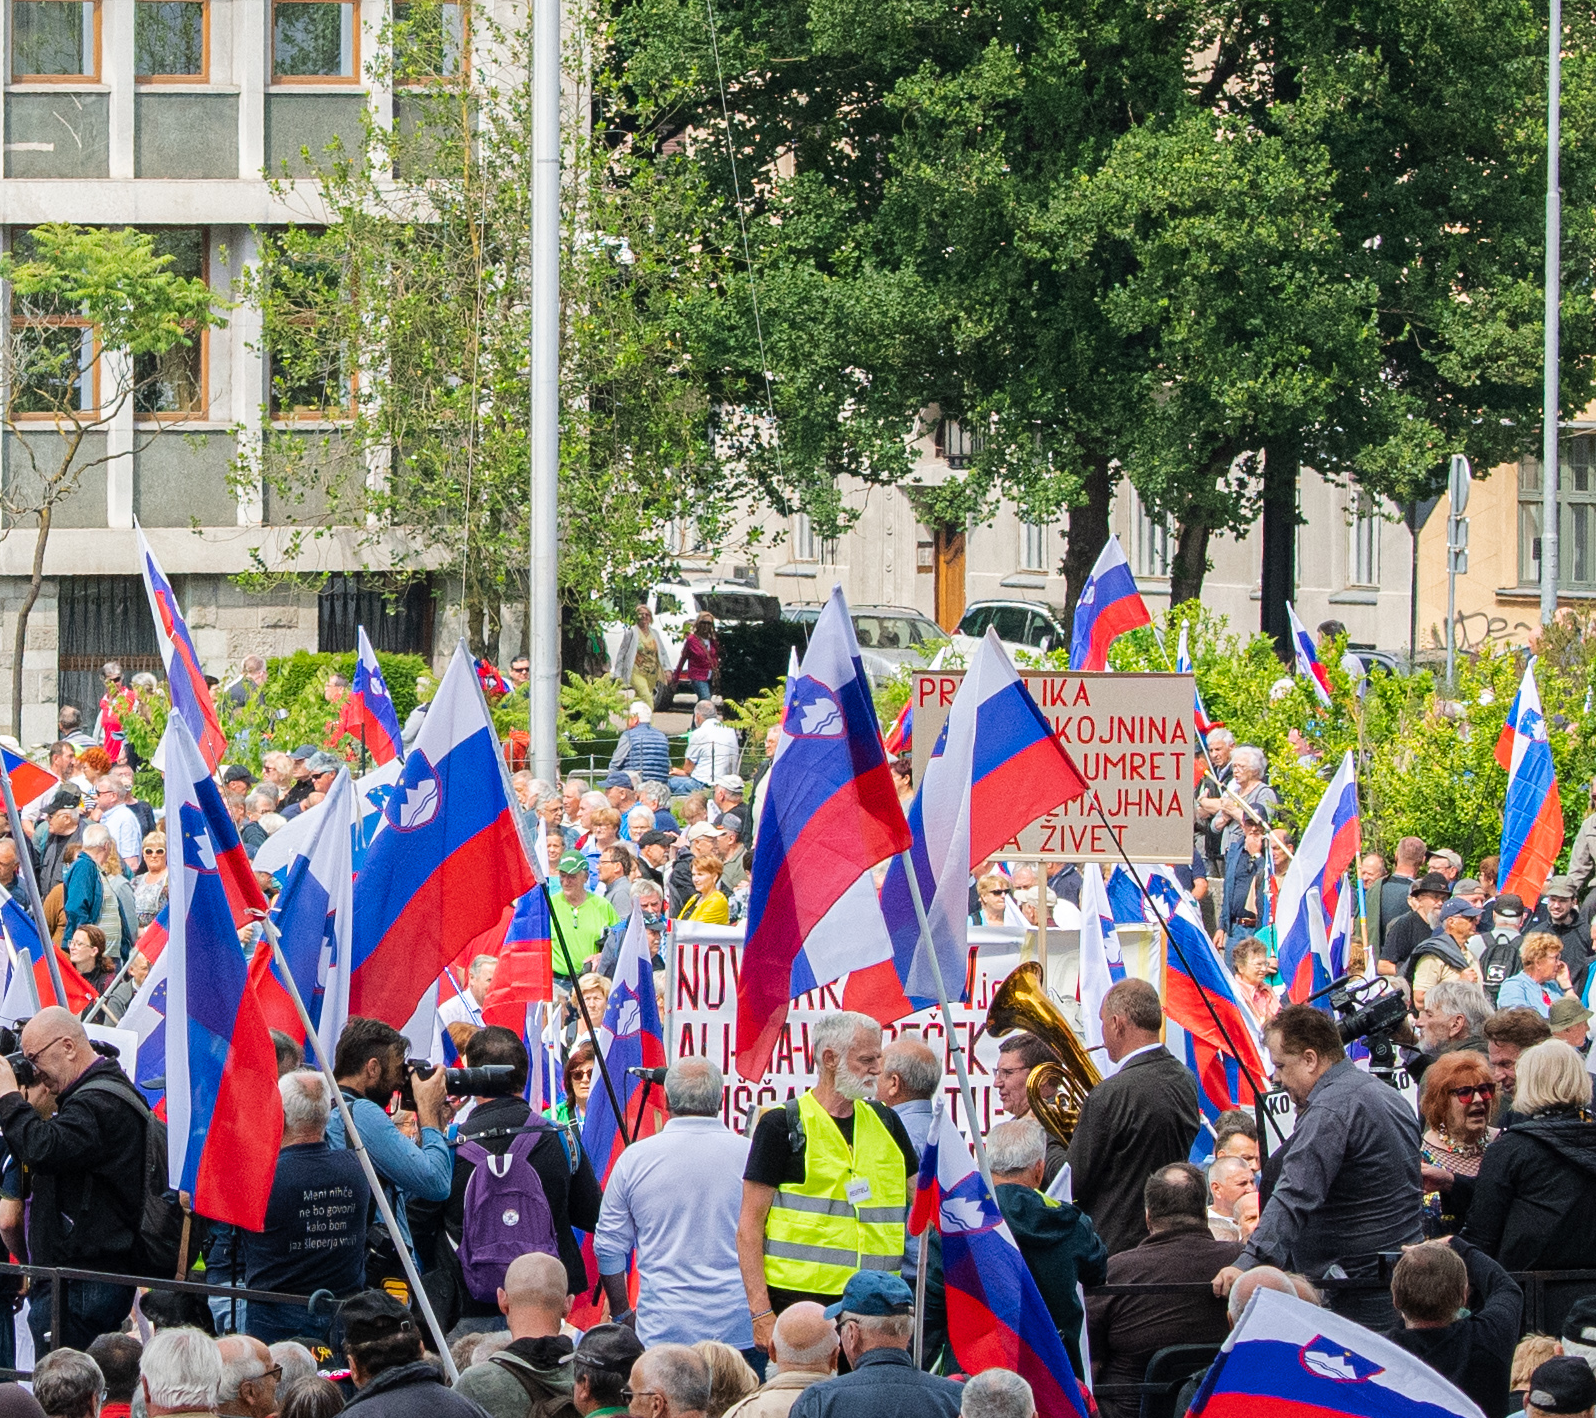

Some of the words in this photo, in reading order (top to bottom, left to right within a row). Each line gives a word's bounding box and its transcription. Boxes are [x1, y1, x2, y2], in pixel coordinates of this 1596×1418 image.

[1083, 752, 1186, 781] UMRET
[1039, 819, 1129, 853] ŽIVET
[299, 1209, 311, 1219] ne
[312, 1204, 325, 1217] bo
[306, 1221, 327, 1233] kako
[328, 1219, 347, 1231] bom
